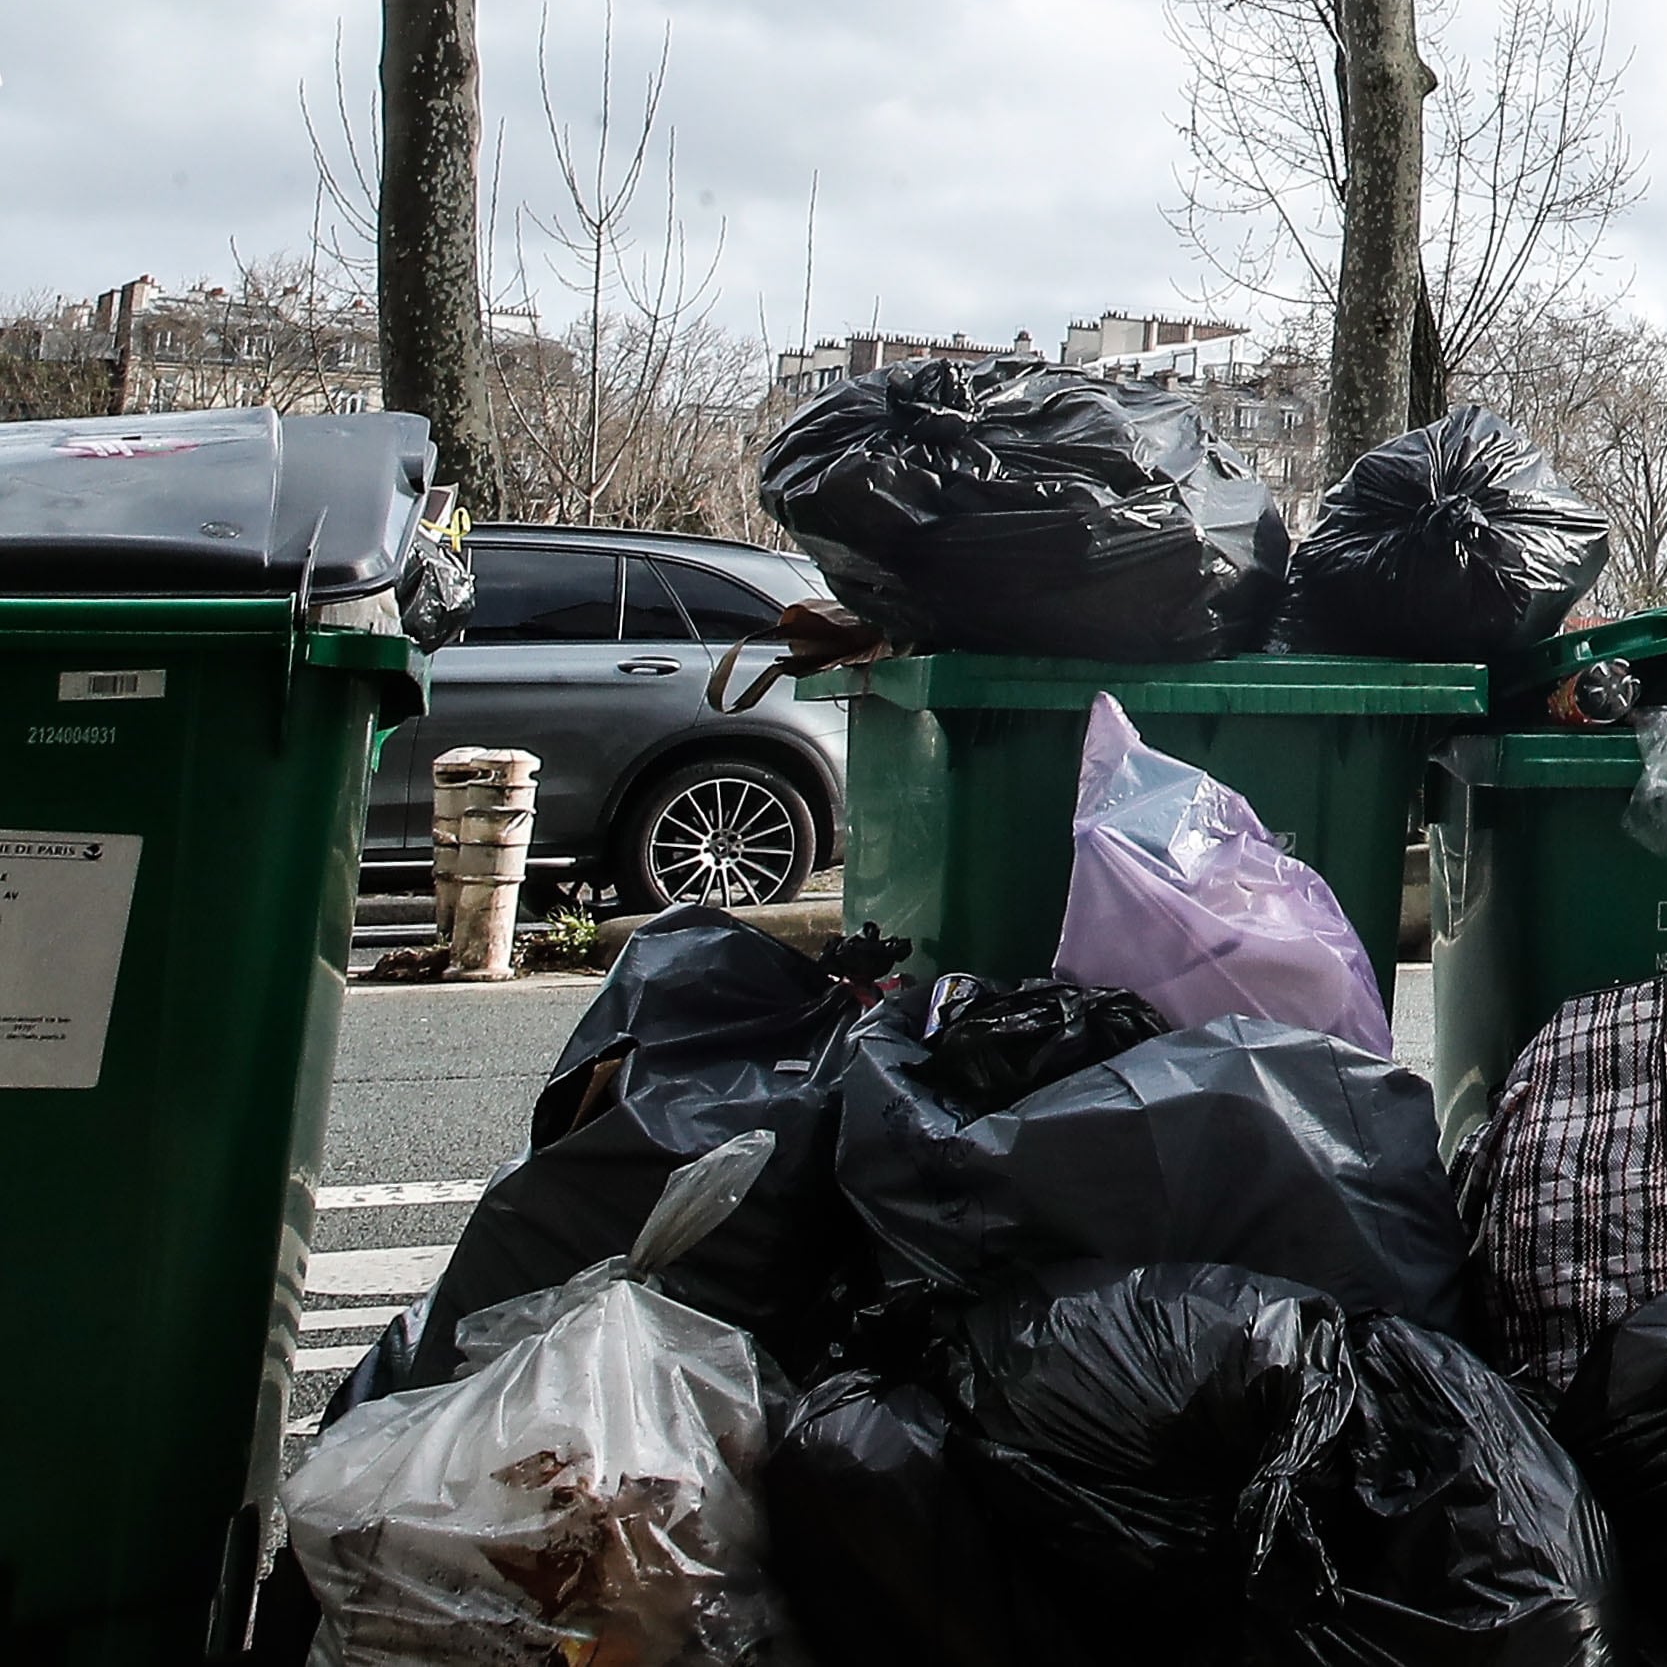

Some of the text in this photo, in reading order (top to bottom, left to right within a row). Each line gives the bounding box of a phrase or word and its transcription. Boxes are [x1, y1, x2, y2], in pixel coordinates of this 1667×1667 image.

[28, 727, 116, 744] 2124004931
[15, 844, 30, 855] DE
[37, 844, 75, 856] PARIS
